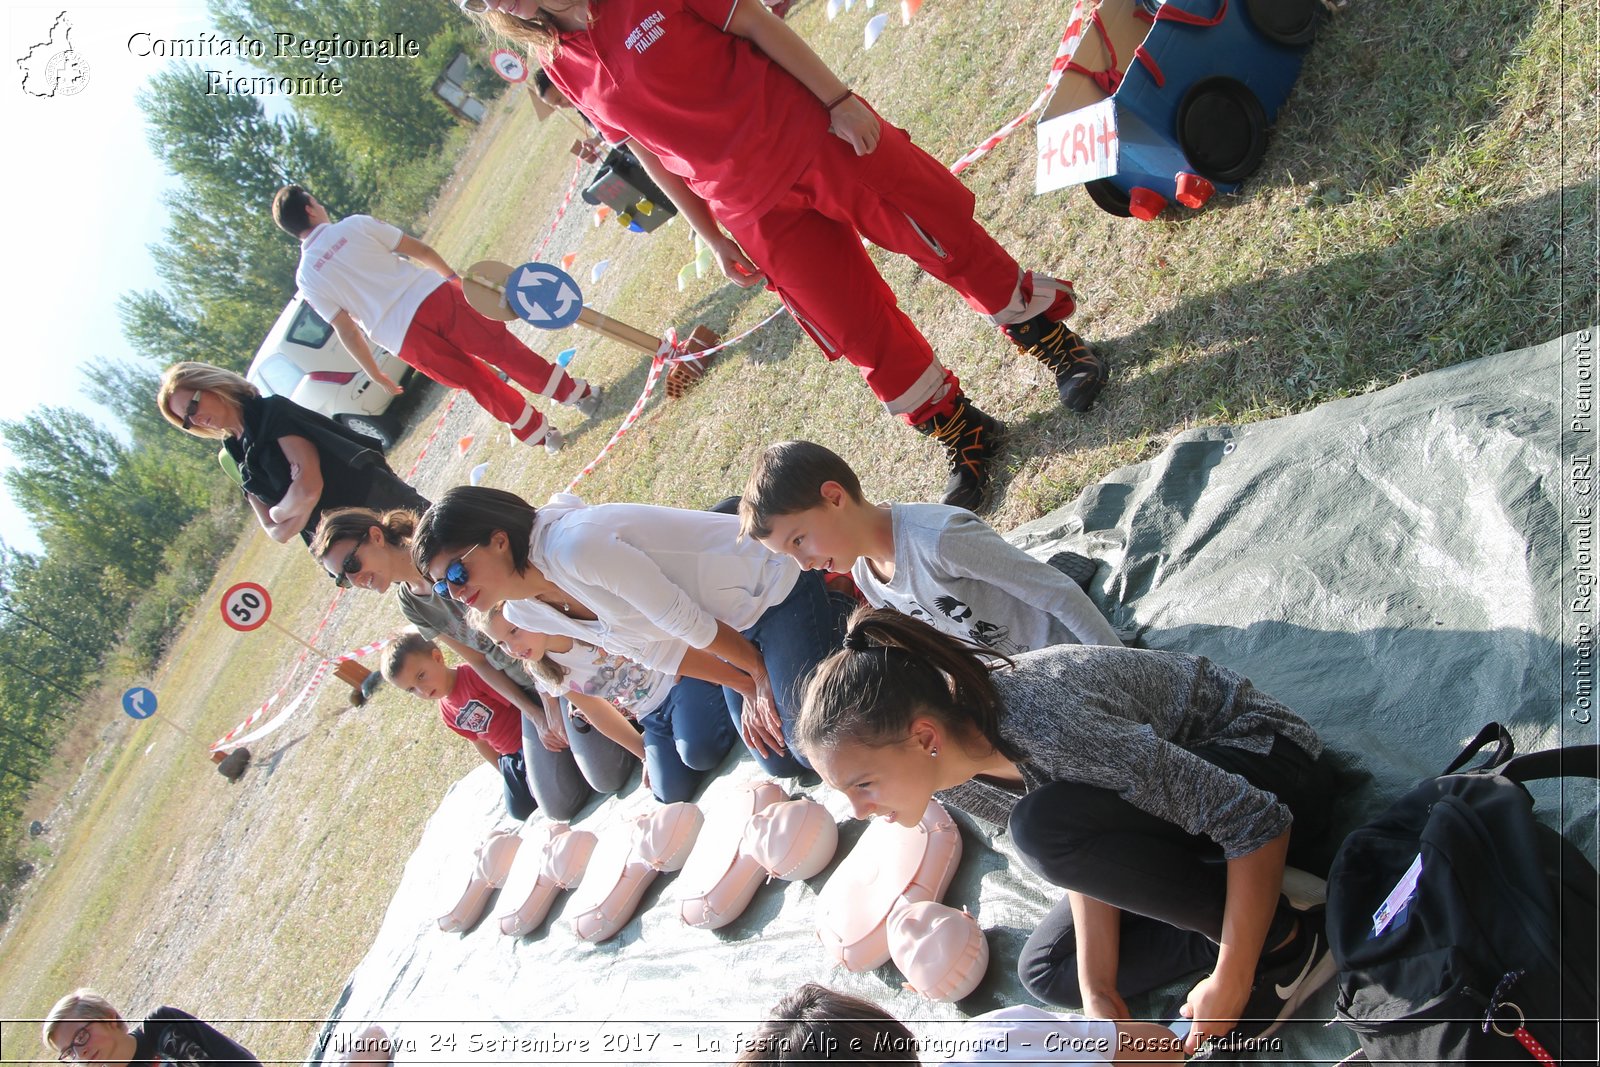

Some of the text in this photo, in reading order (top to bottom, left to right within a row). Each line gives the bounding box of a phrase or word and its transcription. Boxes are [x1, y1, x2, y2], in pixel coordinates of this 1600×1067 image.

[624, 10, 666, 50] CROCE ROSSA
[634, 24, 666, 54] ITALIANA
[231, 592, 260, 622] 50
